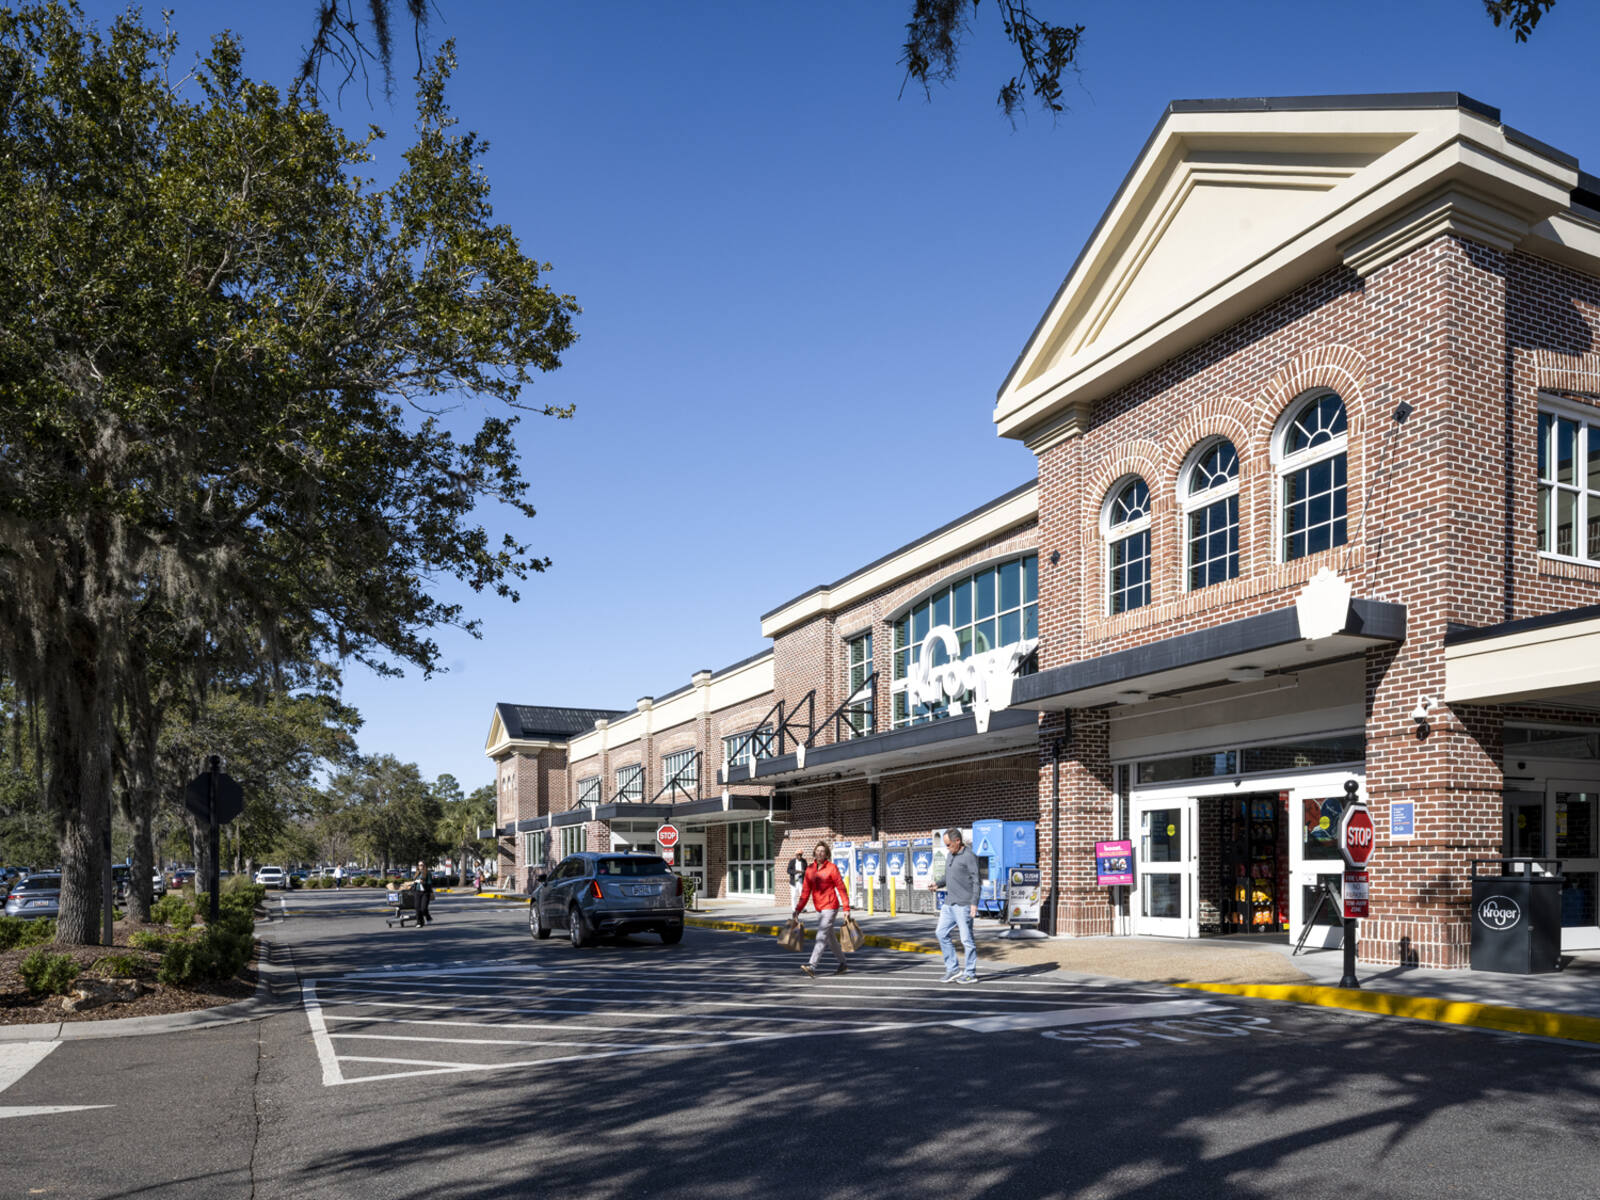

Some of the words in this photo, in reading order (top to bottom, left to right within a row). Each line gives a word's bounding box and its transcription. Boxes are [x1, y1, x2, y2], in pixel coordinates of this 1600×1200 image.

[659, 831, 676, 840] STOP
[1348, 827, 1372, 846] STOP
[1483, 901, 1517, 925] Kroger
[1041, 1014, 1284, 1049] STOP
